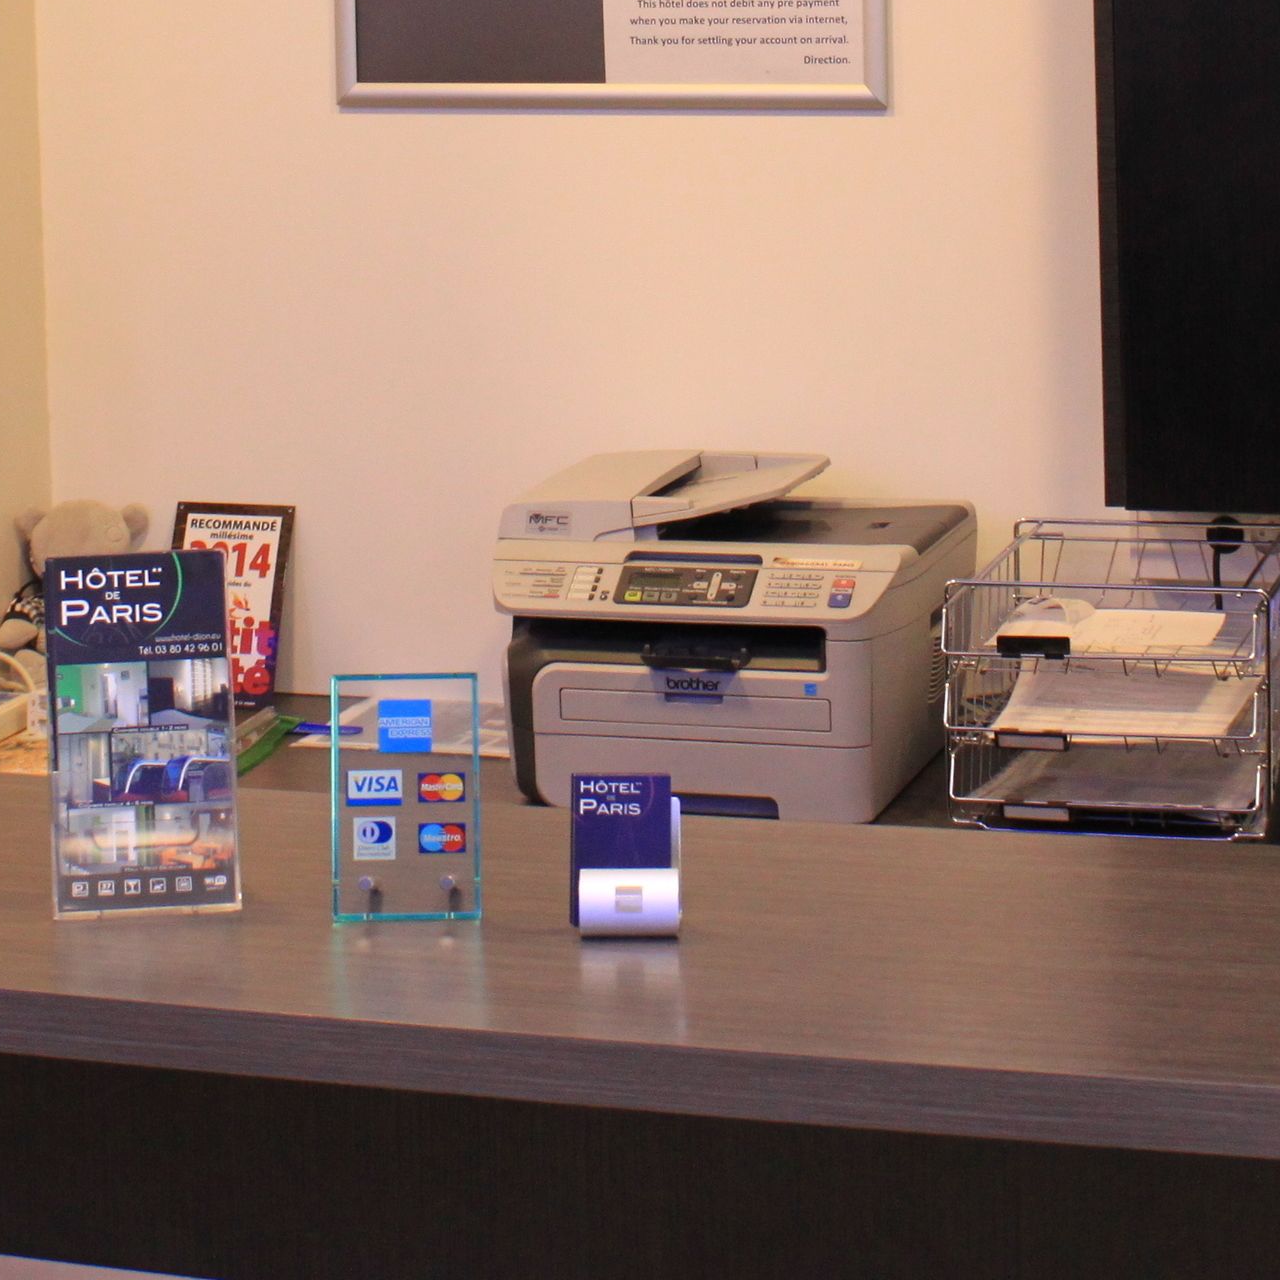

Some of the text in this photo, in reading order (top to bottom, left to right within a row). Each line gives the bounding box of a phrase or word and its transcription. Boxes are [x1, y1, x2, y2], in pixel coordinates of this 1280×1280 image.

[638, 0, 656, 8] This
[659, 0, 684, 8] hôtel
[686, 0, 709, 8] does
[711, 0, 727, 7] not
[730, 0, 754, 7] debit
[757, 0, 775, 9] any
[778, 0, 793, 9] pre
[630, 15, 847, 26] when you make your reservation via internet,
[630, 35, 848, 46] Thank you for settling your account on arrival.
[804, 56, 851, 65] Direction.
[191, 519, 278, 531] RECOMMANDÉ
[529, 514, 569, 525] MFC
[210, 531, 254, 541] millésime
[105, 591, 121, 600] DE
[61, 599, 162, 626] PARIS
[155, 645, 166, 654] 03
[170, 645, 181, 653] 80
[184, 644, 194, 653] 42
[198, 644, 210, 652] 96
[212, 643, 222, 651] 01
[665, 676, 720, 693] brother
[380, 718, 430, 726] AMERICAN
[390, 729, 432, 737] EXPRESS
[354, 776, 399, 792] VISA
[421, 783, 463, 791] MasterCard
[580, 799, 641, 815] PARIS
